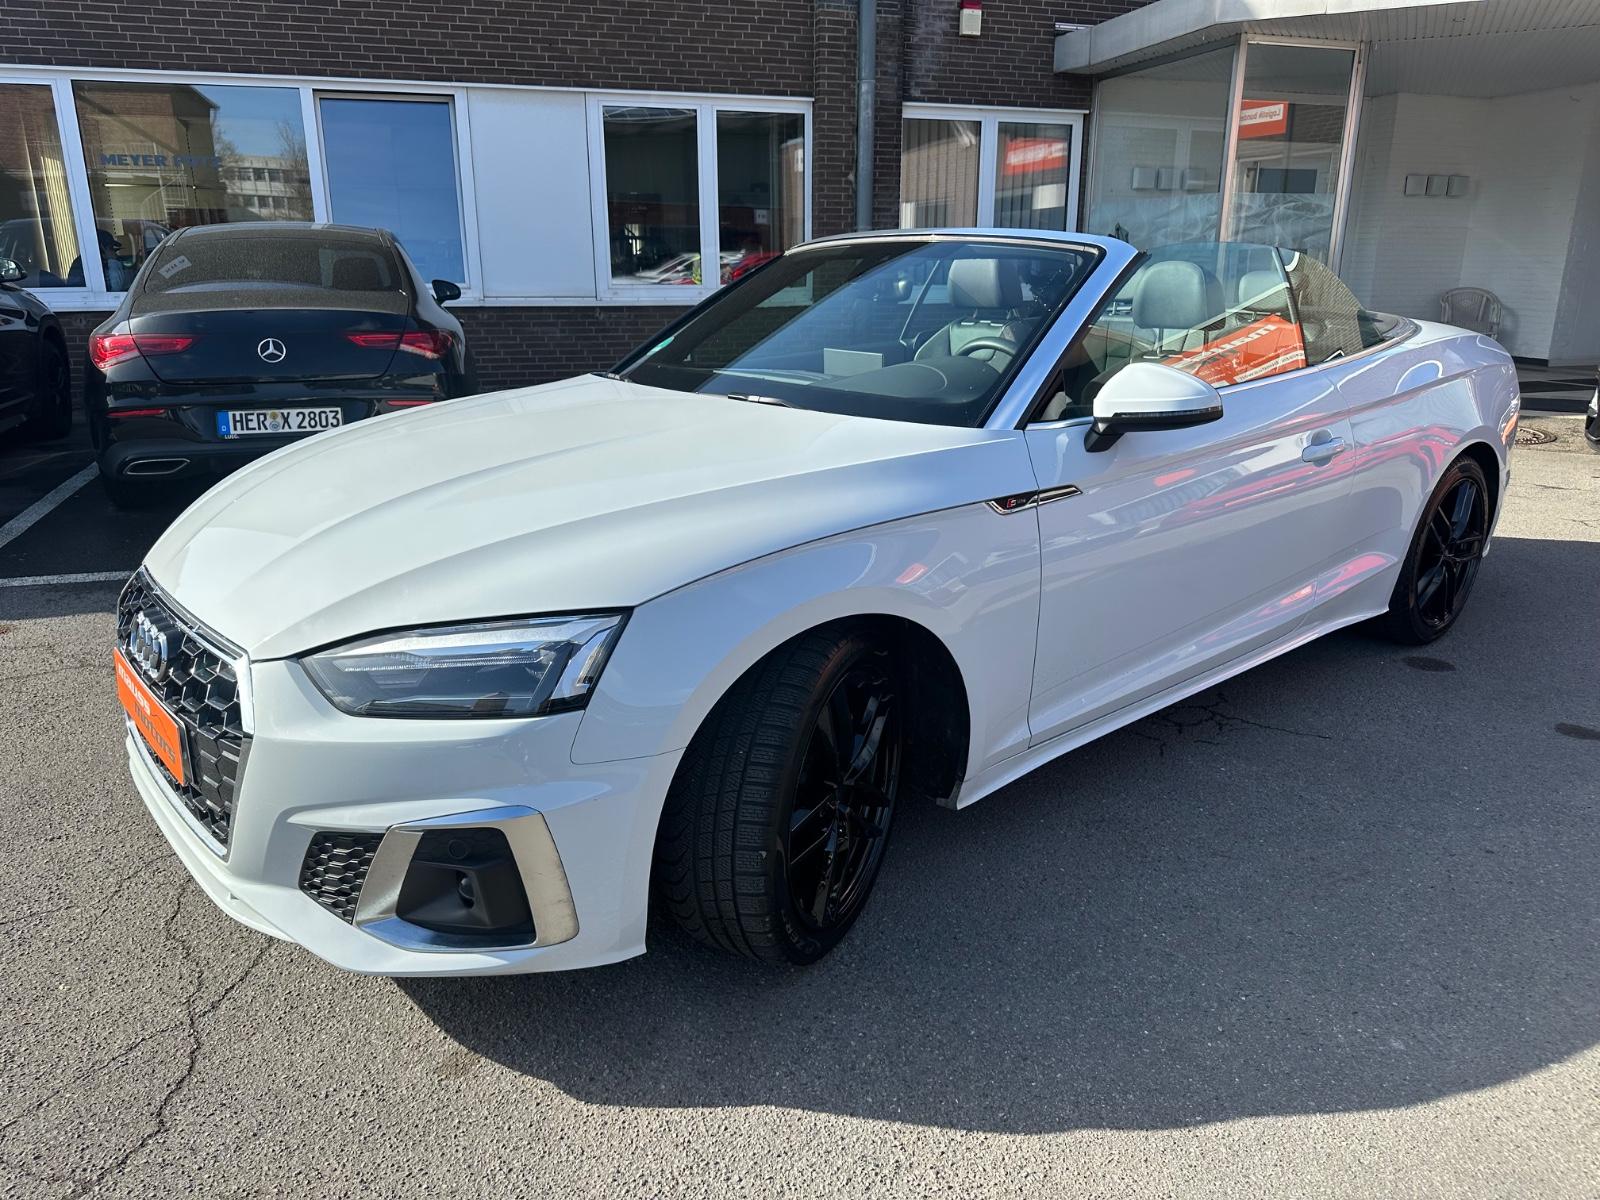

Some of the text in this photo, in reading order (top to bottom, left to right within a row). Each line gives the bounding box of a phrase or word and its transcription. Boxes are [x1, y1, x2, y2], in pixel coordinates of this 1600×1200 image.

[100, 154, 167, 167] MEYER
[232, 412, 268, 431] HER
[281, 411, 292, 430] X
[296, 410, 340, 429] 2803
